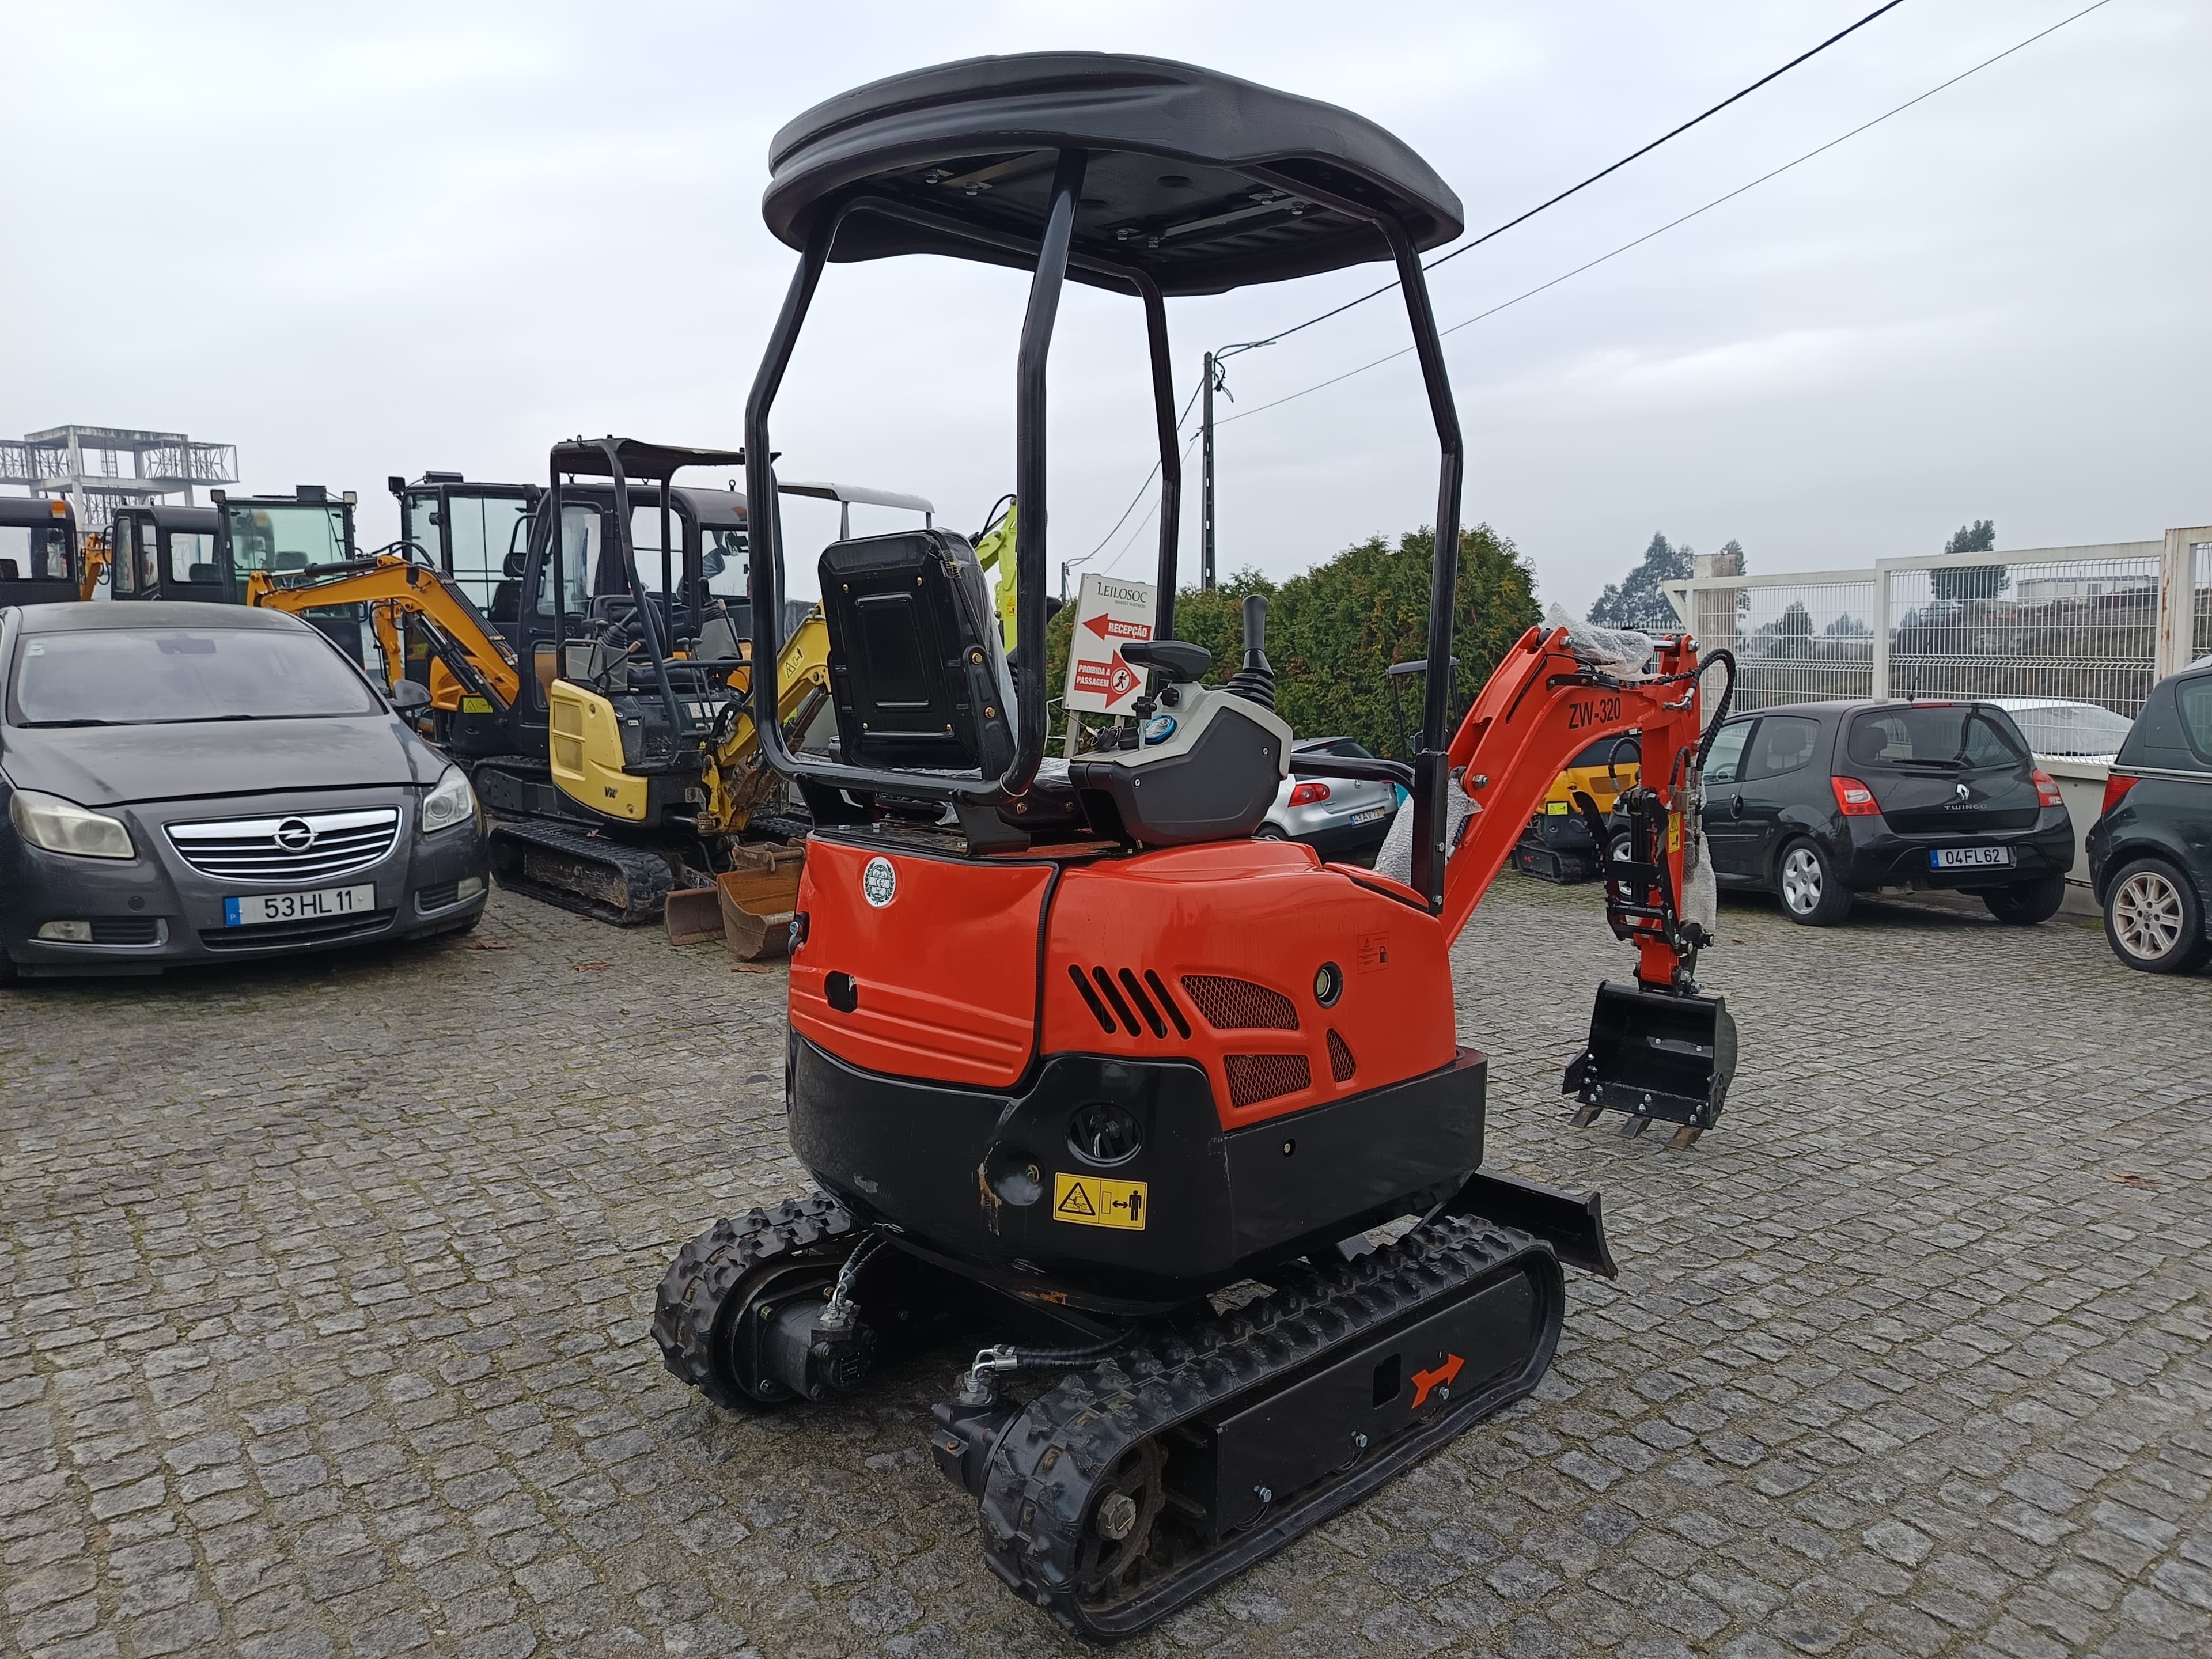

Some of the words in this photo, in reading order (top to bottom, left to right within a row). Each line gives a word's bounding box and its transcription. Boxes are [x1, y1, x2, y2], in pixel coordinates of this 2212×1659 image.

[1097, 582, 1147, 603] LEILOSOC
[1108, 622, 1147, 638] RECEPÇÃO
[1078, 665, 1105, 676] PROIBIDA
[1106, 668, 1111, 676] A
[1077, 676, 1109, 687] PASSAGEM
[1569, 697, 1621, 729] ZW-320
